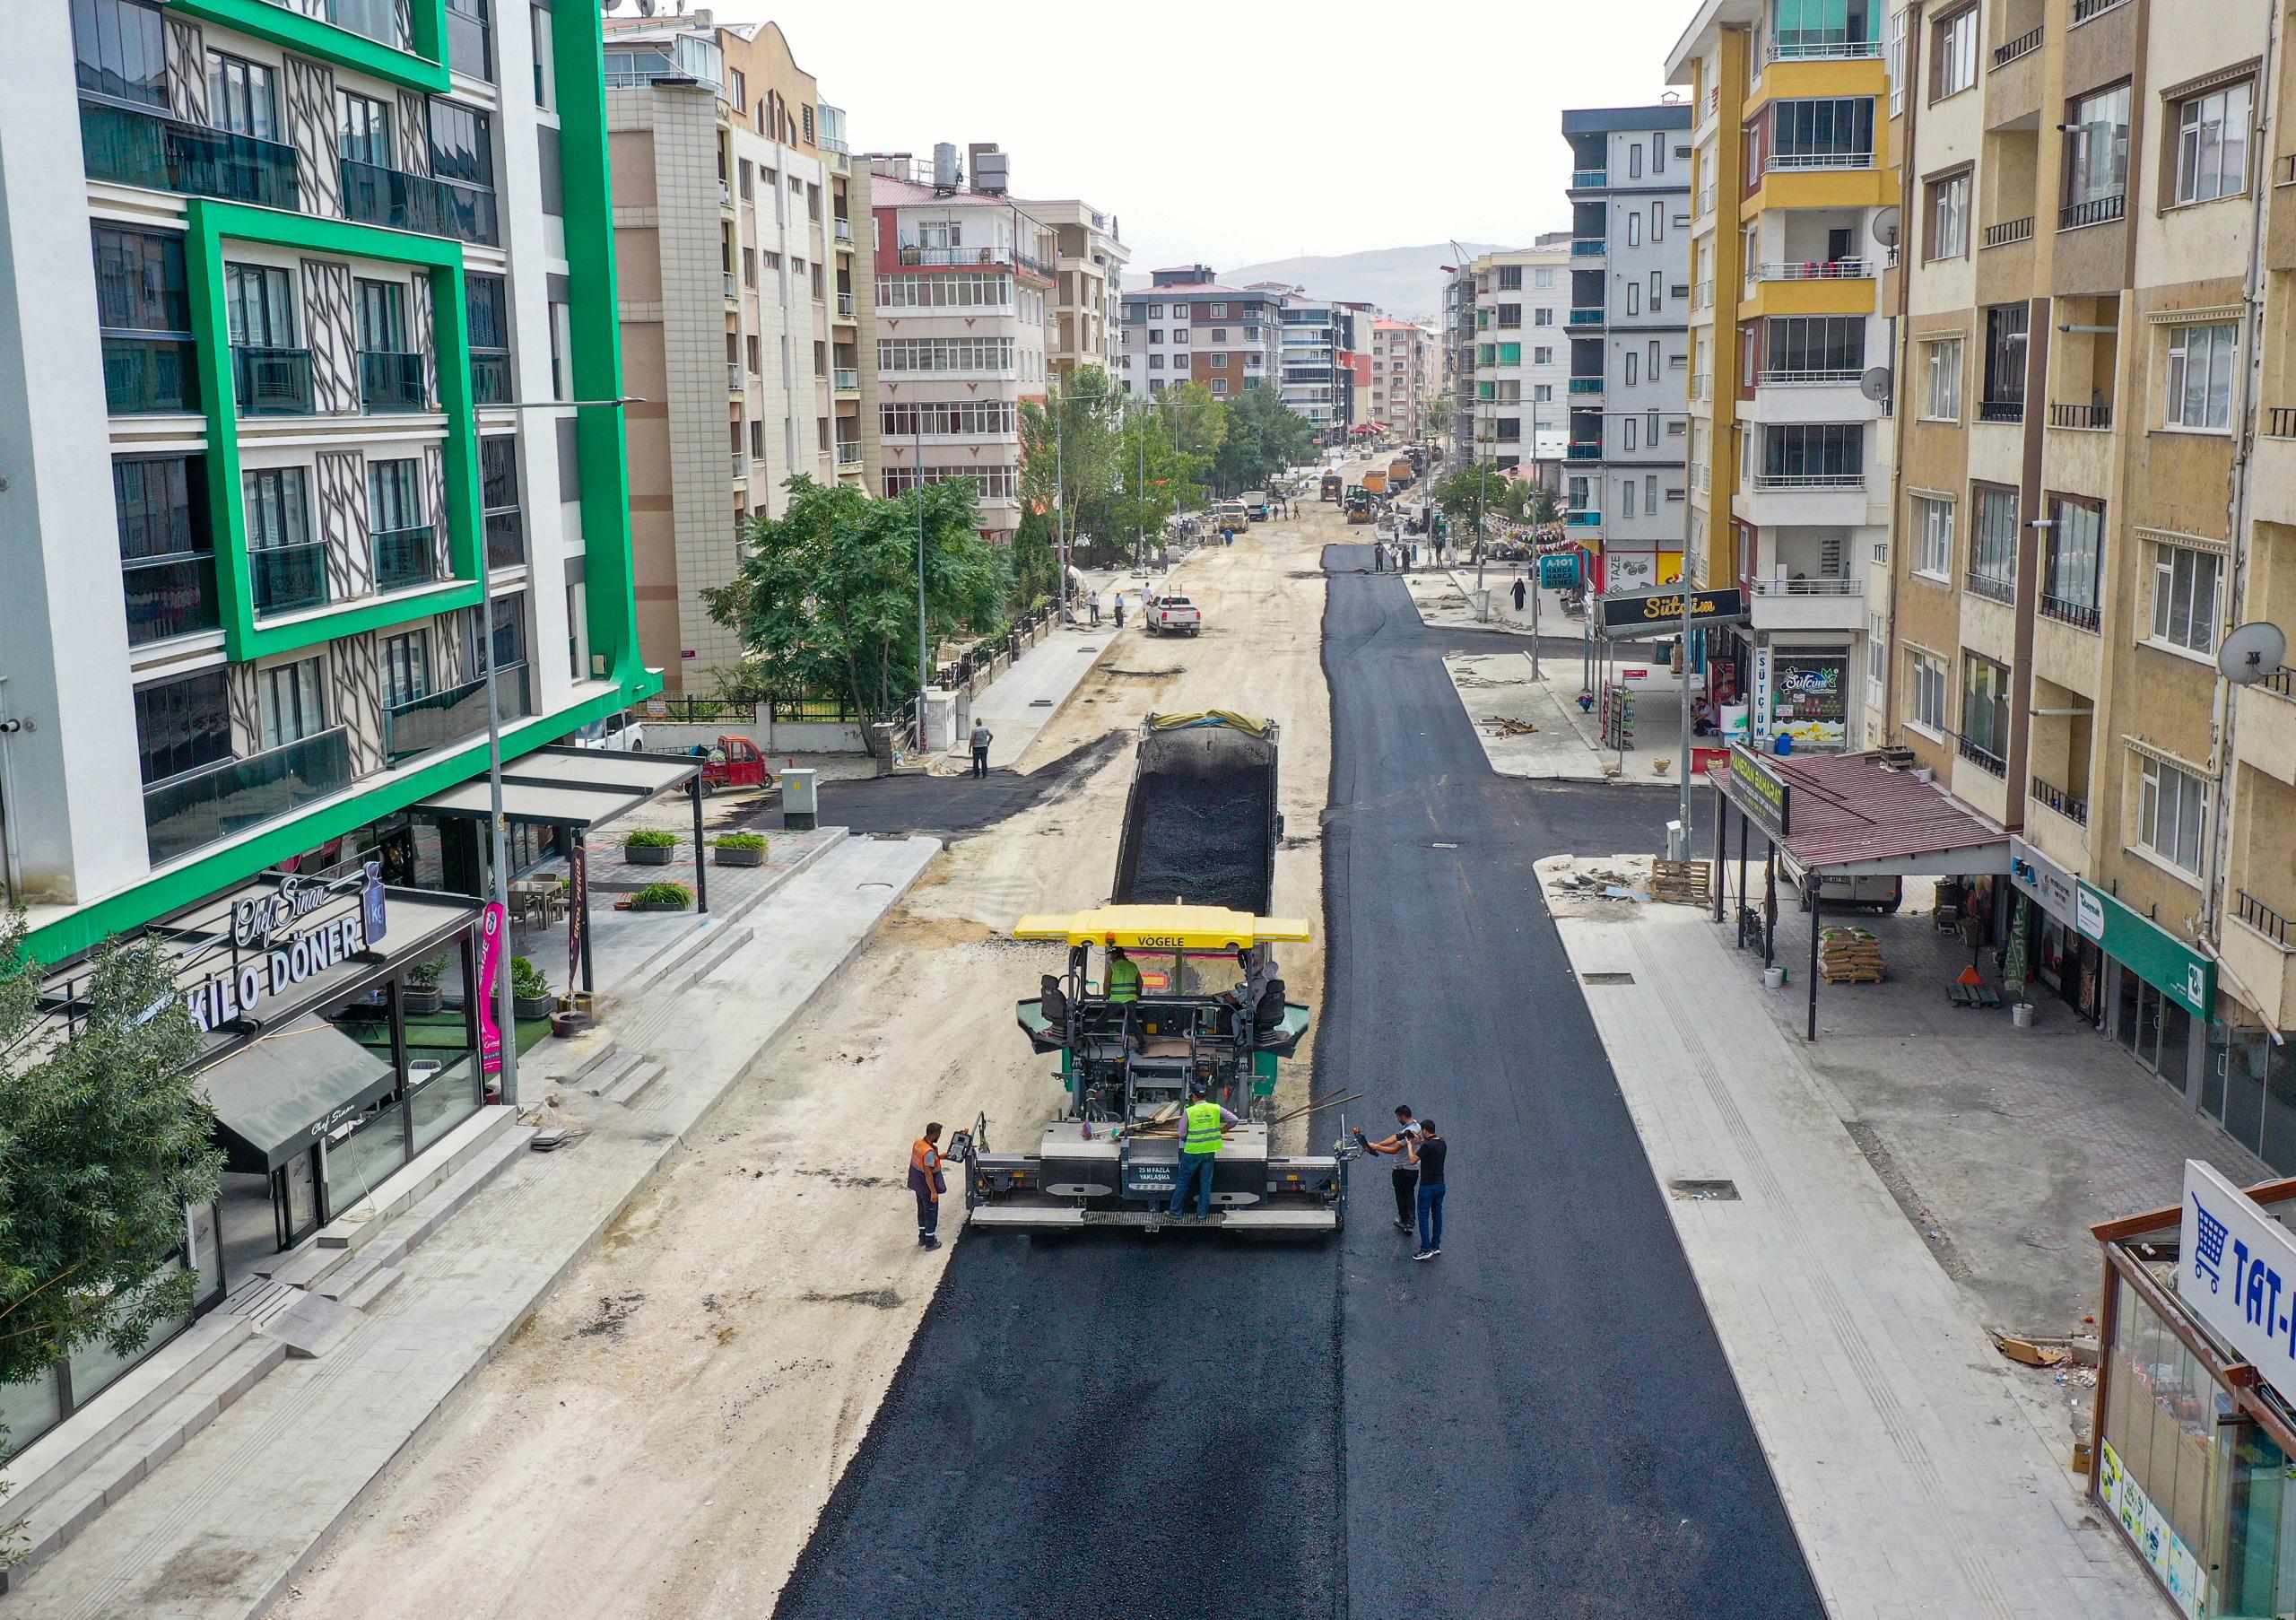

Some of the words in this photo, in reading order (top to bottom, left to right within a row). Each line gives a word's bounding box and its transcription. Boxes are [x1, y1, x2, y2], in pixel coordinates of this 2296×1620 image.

[1611, 555, 1620, 581] TAZE
[1756, 657, 1765, 736] SÜTÇÜM
[267, 916, 361, 997] DÖNER
[2232, 1238, 2296, 1360] TAT-
